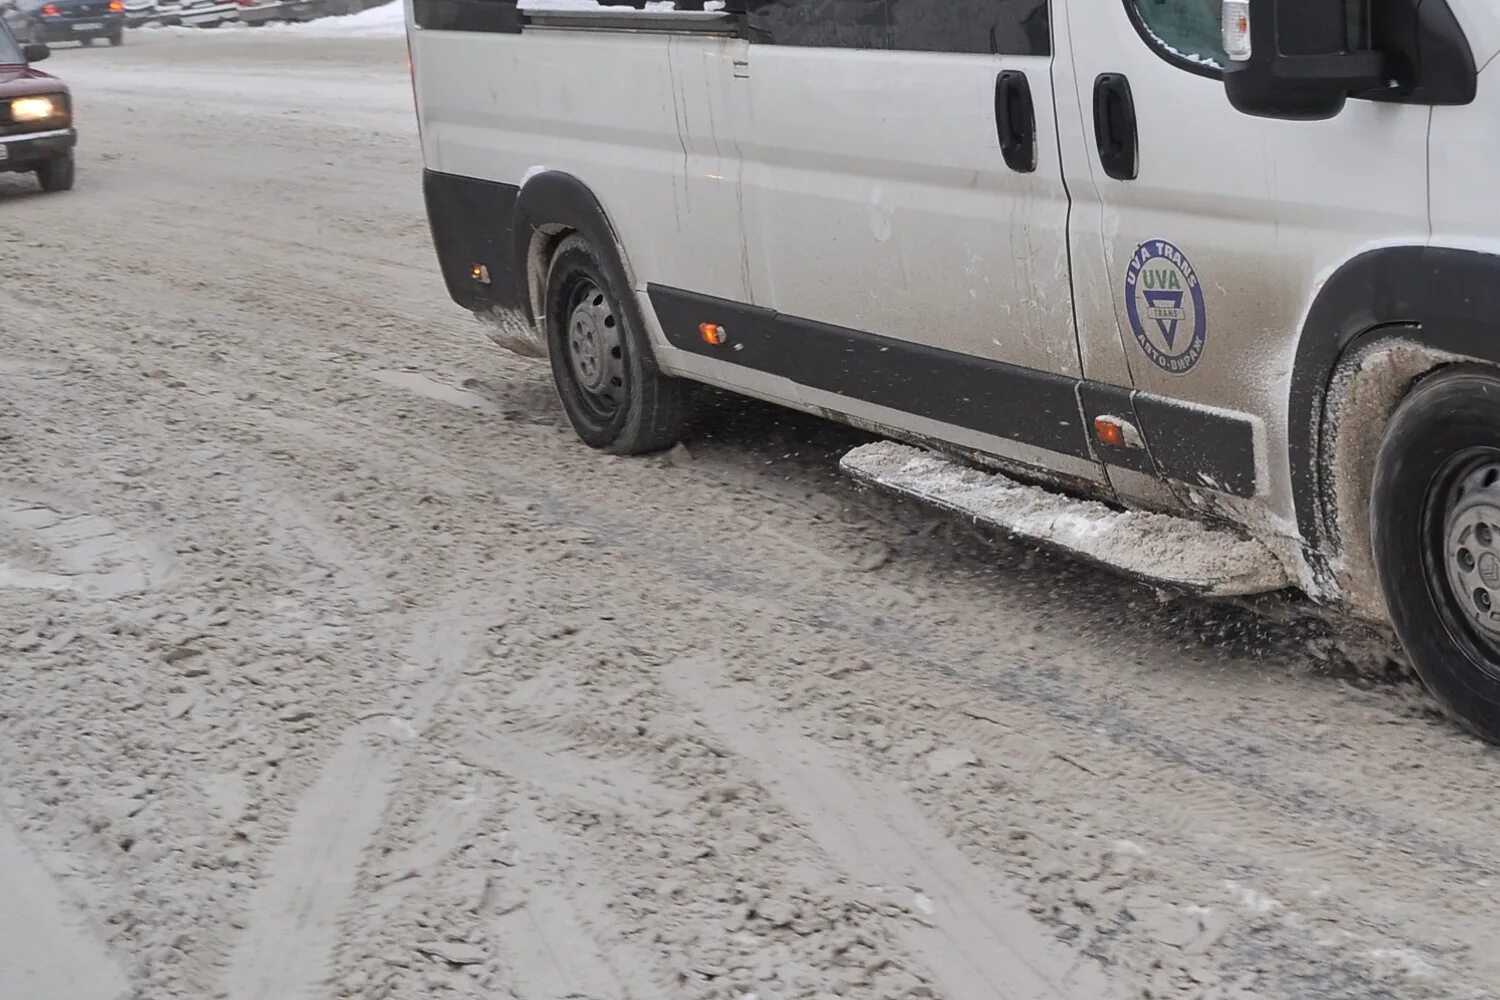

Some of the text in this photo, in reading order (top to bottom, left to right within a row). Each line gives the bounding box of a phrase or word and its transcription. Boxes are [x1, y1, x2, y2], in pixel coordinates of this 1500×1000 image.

[1127, 242, 1197, 288] UVA TRANS
[1143, 269, 1181, 290] UVA
